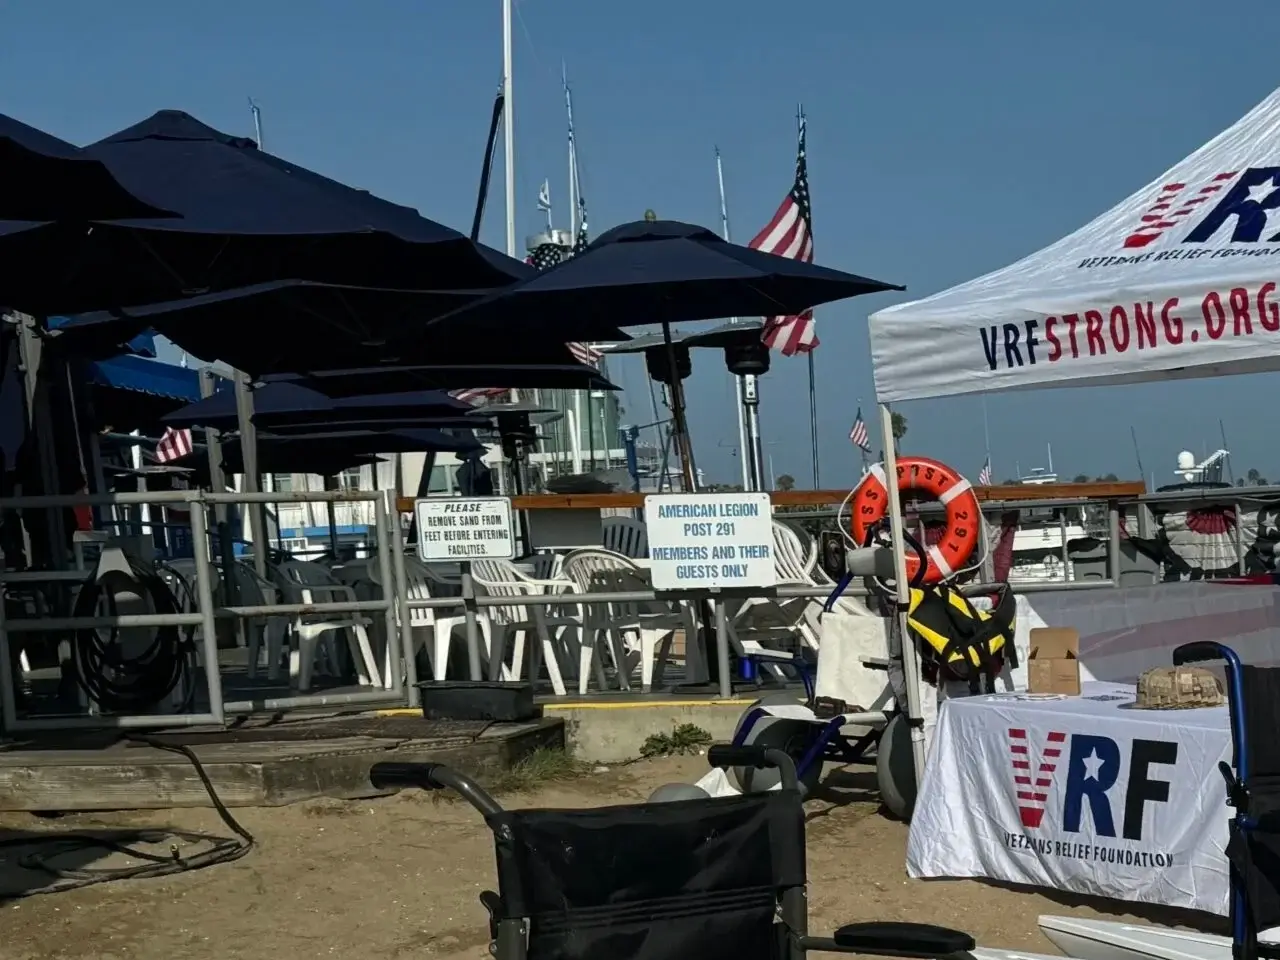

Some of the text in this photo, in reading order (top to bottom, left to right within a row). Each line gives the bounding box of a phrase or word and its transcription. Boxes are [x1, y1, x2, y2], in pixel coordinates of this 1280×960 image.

[1153, 248, 1212, 262] RELIEF
[979, 281, 1280, 371] VRFSTRONG.ORG
[444, 503, 482, 513] PLEASE
[658, 503, 759, 518] AMERICAN LEGION
[428, 514, 502, 527] REMOVE SAND FROM
[424, 529, 509, 542] FEET BEFORE ENTERING
[683, 522, 736, 537] POST 291
[947, 510, 969, 553] 291
[447, 544, 488, 555] FACILITIES.
[652, 544, 770, 561] MEMBERS AND THEIR
[676, 564, 749, 579] GUESTS ONLY
[1008, 728, 1179, 841] VRF
[1004, 832, 1174, 869] VETEANS RELIEF FOUNDATION
